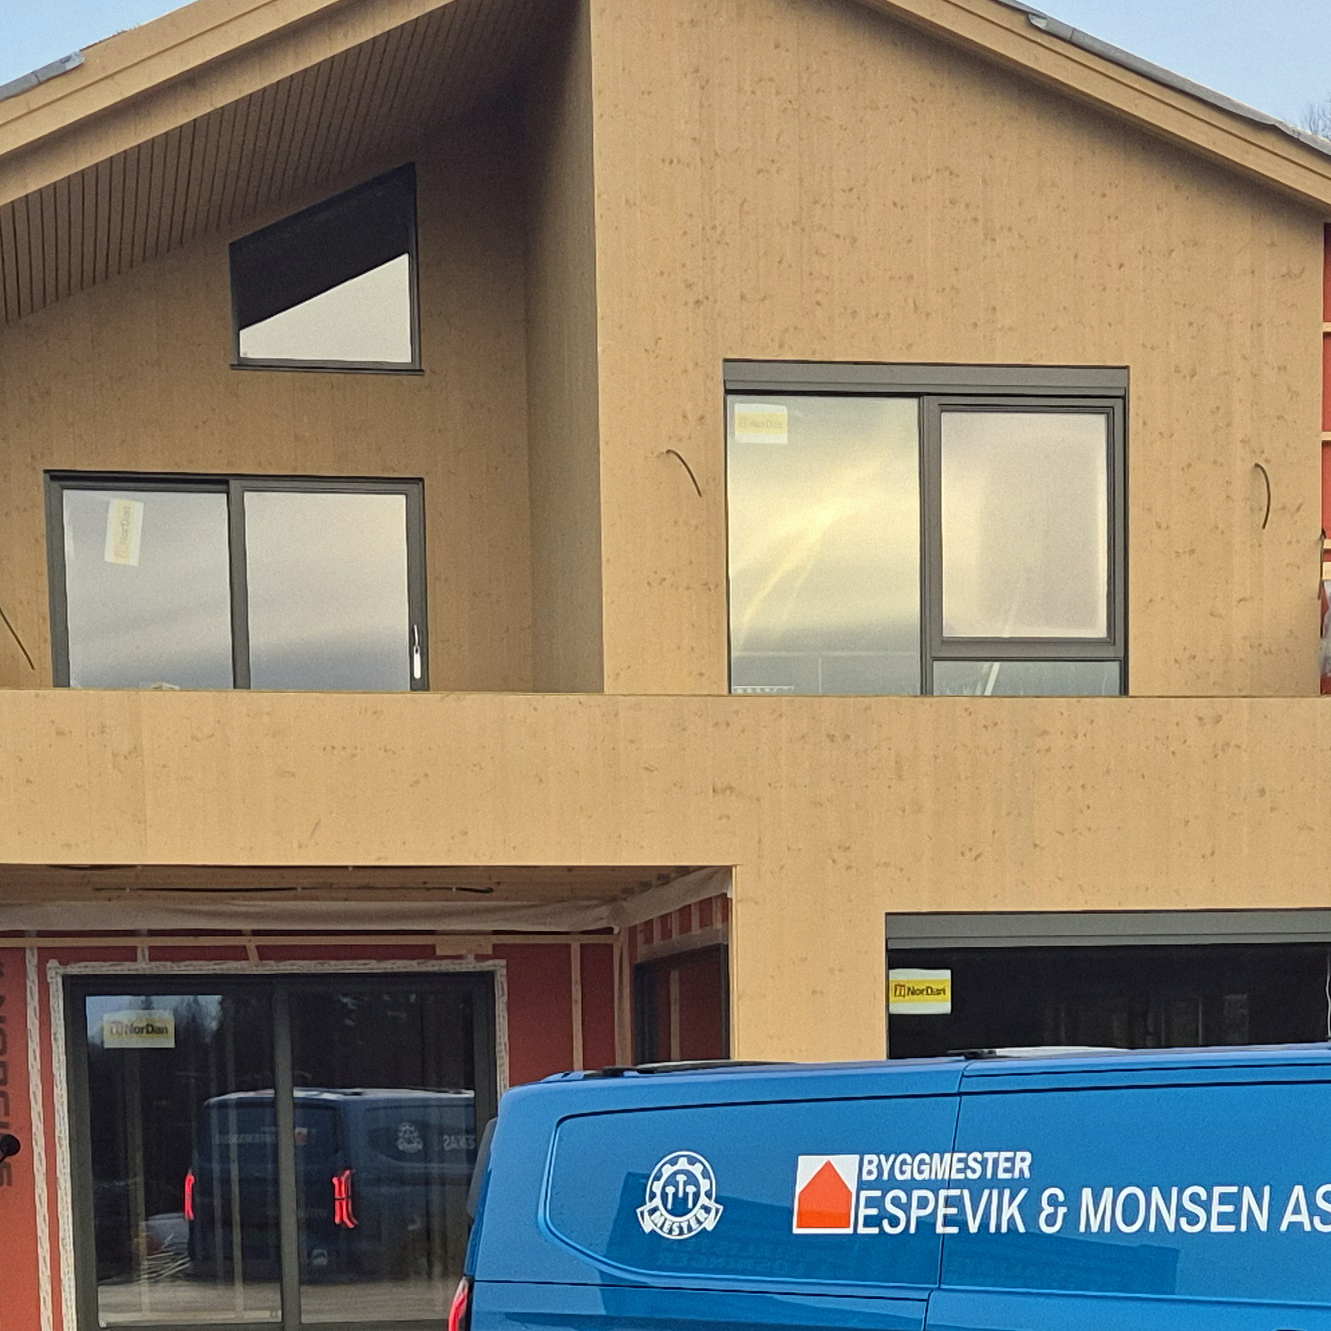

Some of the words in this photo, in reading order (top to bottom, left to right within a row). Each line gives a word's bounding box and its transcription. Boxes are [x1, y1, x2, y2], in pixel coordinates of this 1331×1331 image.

[861, 1151, 1032, 1181] BYGGMESTER
[650, 1209, 709, 1236] MESTER
[856, 1188, 1028, 1235] ESPEVIK
[1038, 1187, 1068, 1234] &
[1079, 1185, 1270, 1234] MONSEN
